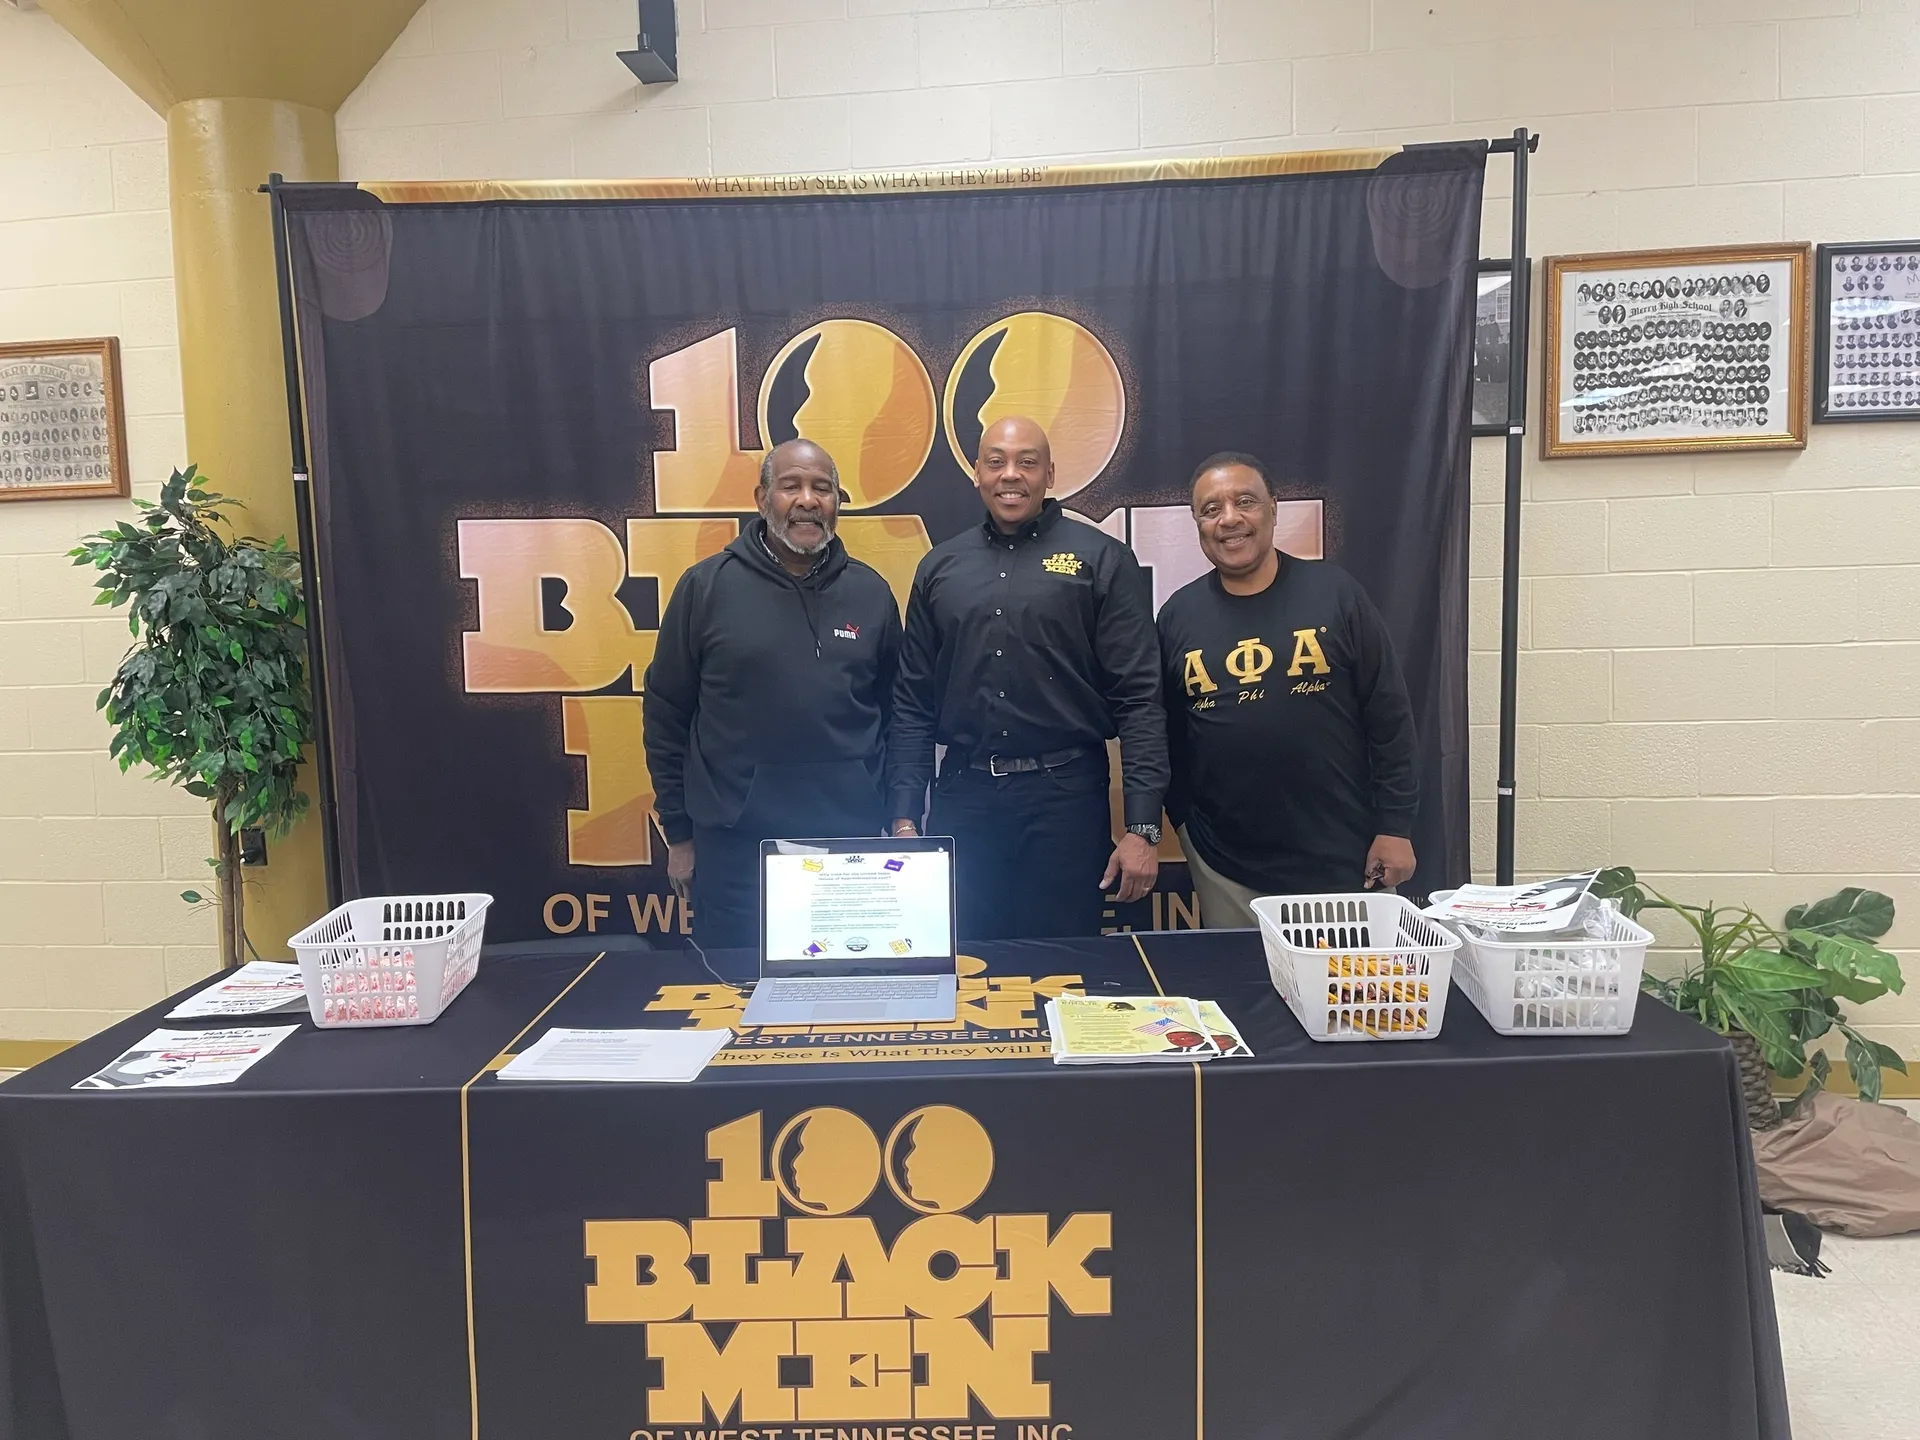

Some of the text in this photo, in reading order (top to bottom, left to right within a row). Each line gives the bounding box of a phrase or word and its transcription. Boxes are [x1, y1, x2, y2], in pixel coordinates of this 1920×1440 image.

[758, 175, 810, 192] THEY
[815, 174, 848, 190] SEE
[852, 174, 867, 190] IS
[871, 171, 933, 189] WHAT
[0, 365, 37, 380] ERRY
[648, 311, 1129, 515] 100
[833, 628, 858, 640] PUMA
[543, 894, 611, 934] OF
[627, 894, 694, 935] WE
[734, 1035, 791, 1045] EST
[772, 1051, 813, 1060] See
[821, 1050, 840, 1058] Is
[849, 1048, 912, 1058] What
[917, 1047, 978, 1057] They
[984, 1045, 1031, 1054] Will
[705, 1104, 996, 1219] 100
[583, 1211, 1113, 1324] BLACK
[646, 1314, 1051, 1426] MEN
